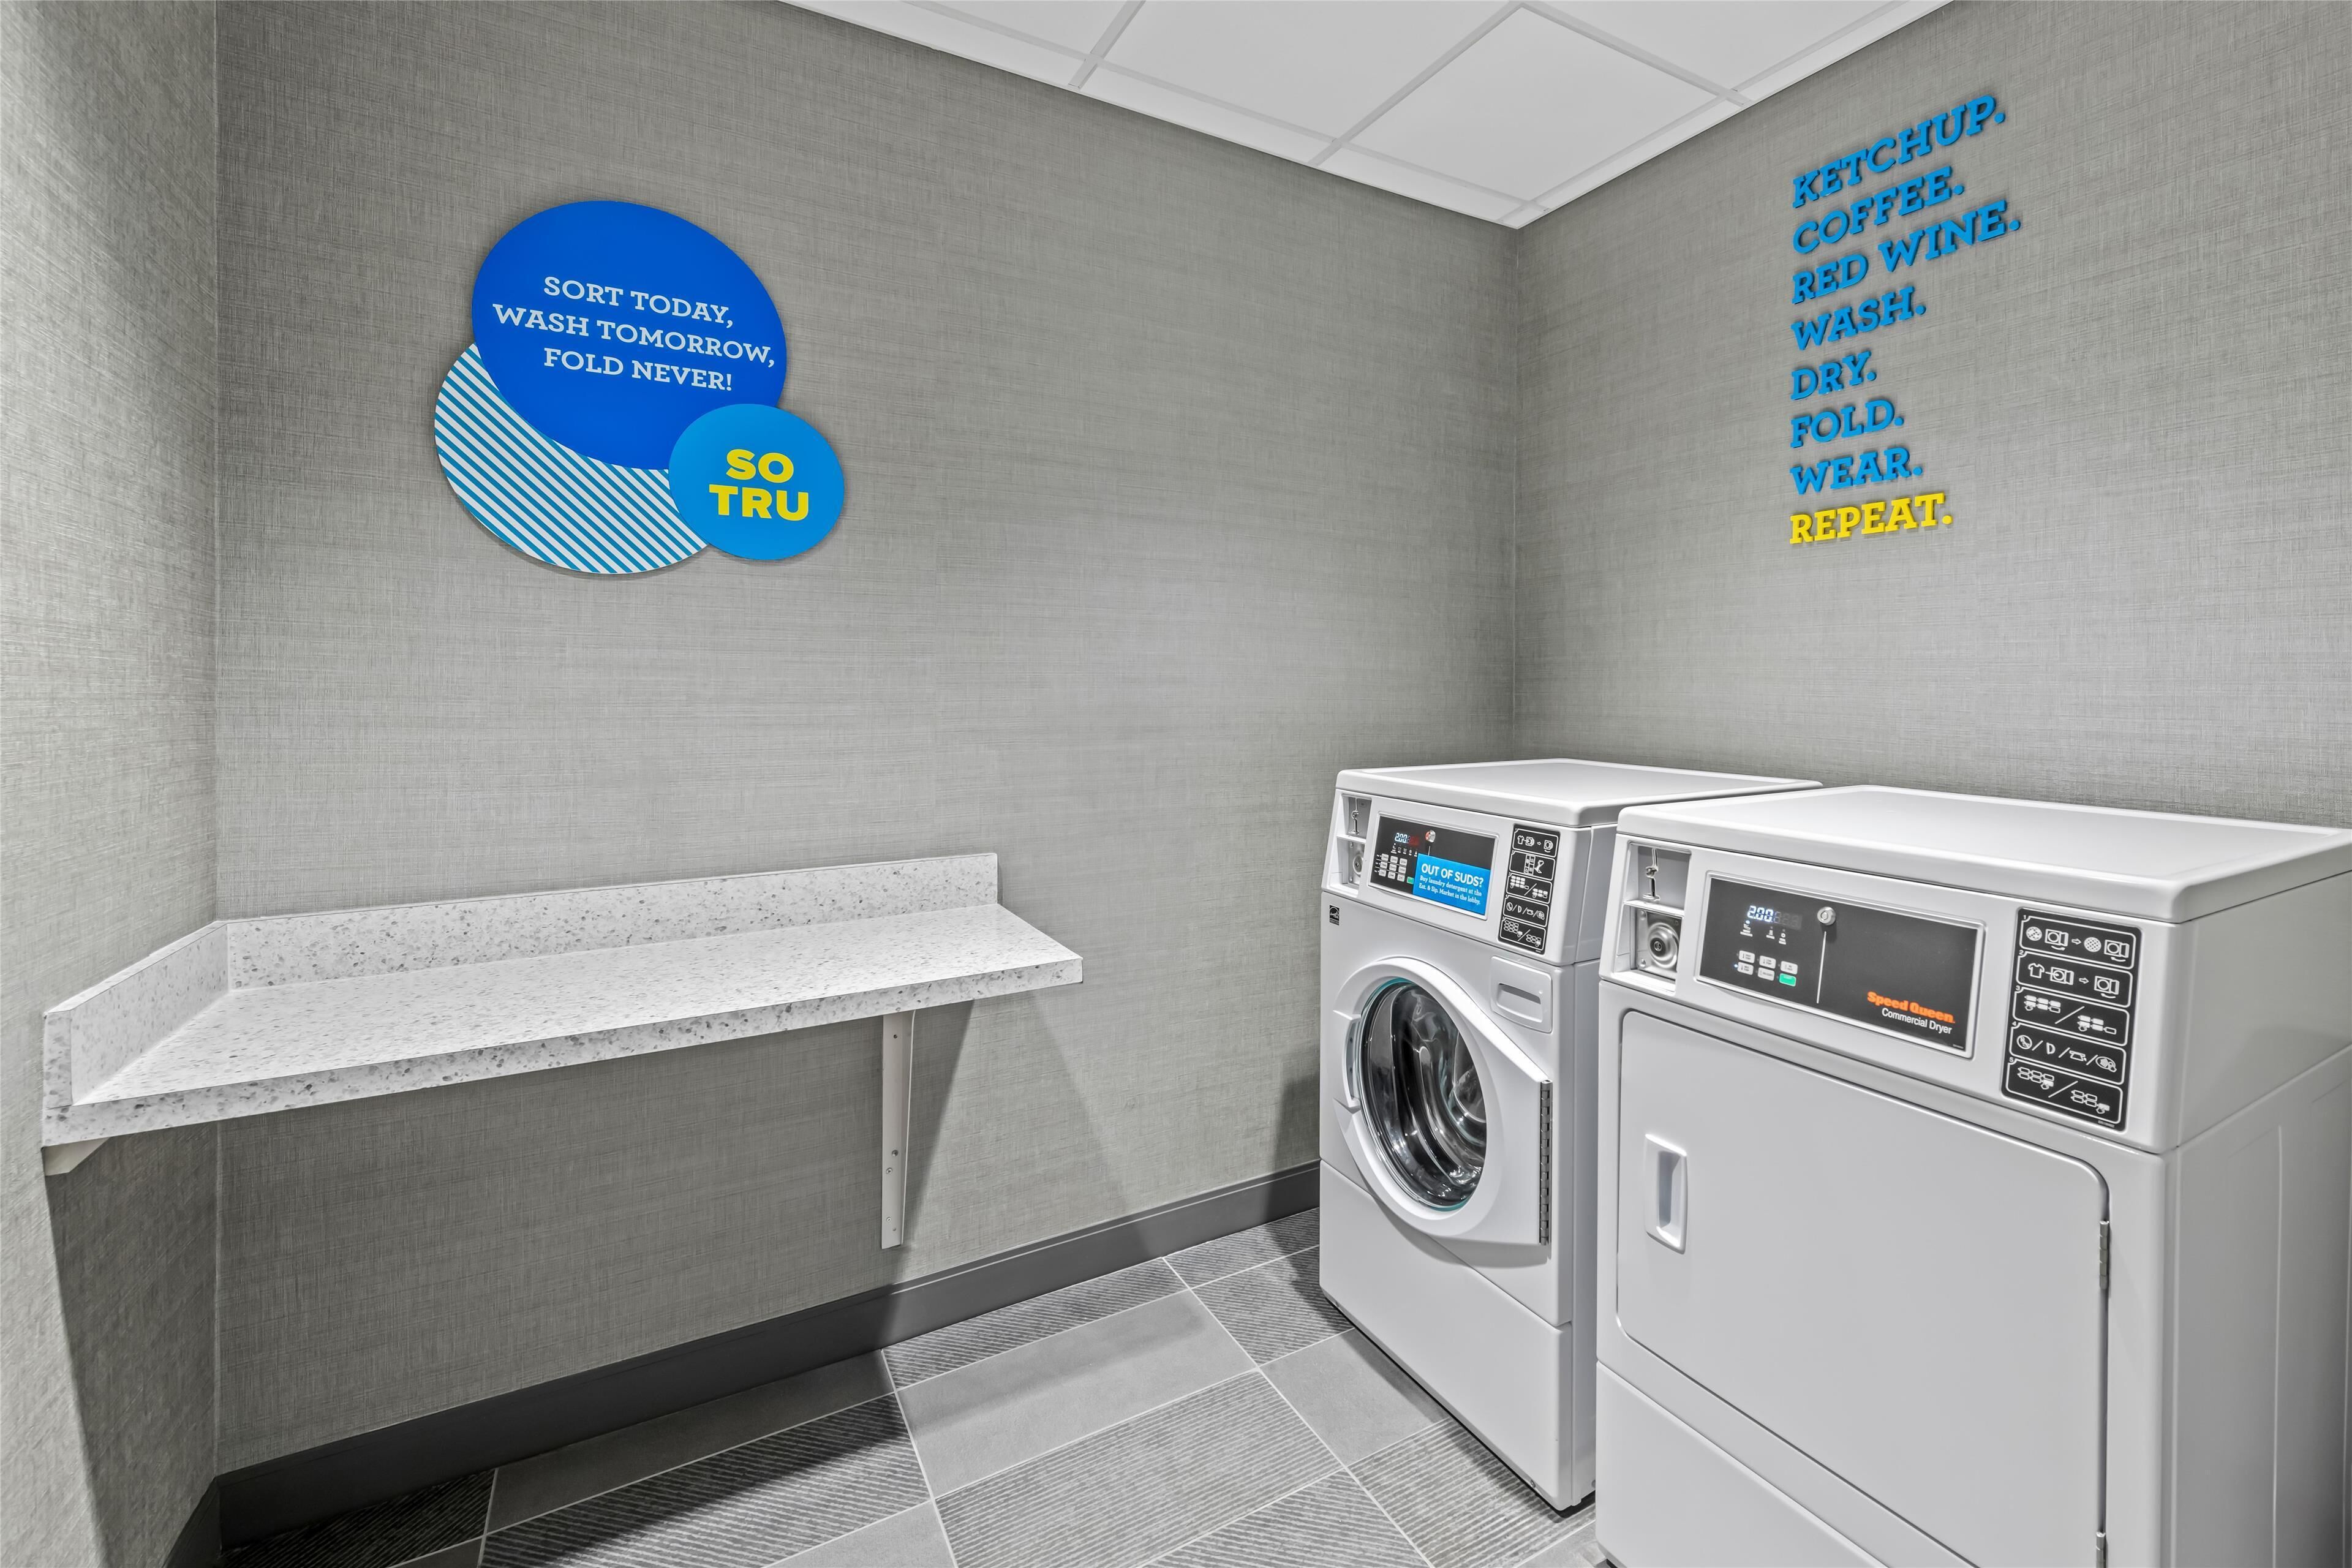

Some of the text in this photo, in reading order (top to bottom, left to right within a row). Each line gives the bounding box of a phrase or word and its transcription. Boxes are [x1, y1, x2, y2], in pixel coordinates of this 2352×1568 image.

[1792, 95, 2006, 209] KETCHUP.
[1792, 165, 1965, 254] COFFEE.
[1791, 199, 2021, 304] RED WINE.
[543, 276, 733, 328] SORT TODAY,
[1790, 285, 1927, 351] WASH.
[492, 303, 774, 368] WASH TOMORROW,
[544, 347, 732, 391] FOLD NEVER!
[1790, 350, 1877, 401] DRY.
[1790, 399, 1904, 448] FOLD.
[726, 449, 794, 483] SO
[1789, 447, 1923, 496] WEAR.
[709, 484, 809, 521] TRU
[1789, 492, 1953, 545] REPEAT.
[1422, 863, 1484, 888] OUT OF SUDS?
[1428, 876, 1446, 888] laundry
[1446, 882, 1468, 892] detergent
[1439, 888, 1455, 898] Market
[1867, 991, 1909, 1011] Speed
[1882, 1008, 1953, 1035] Commercial Dryer
